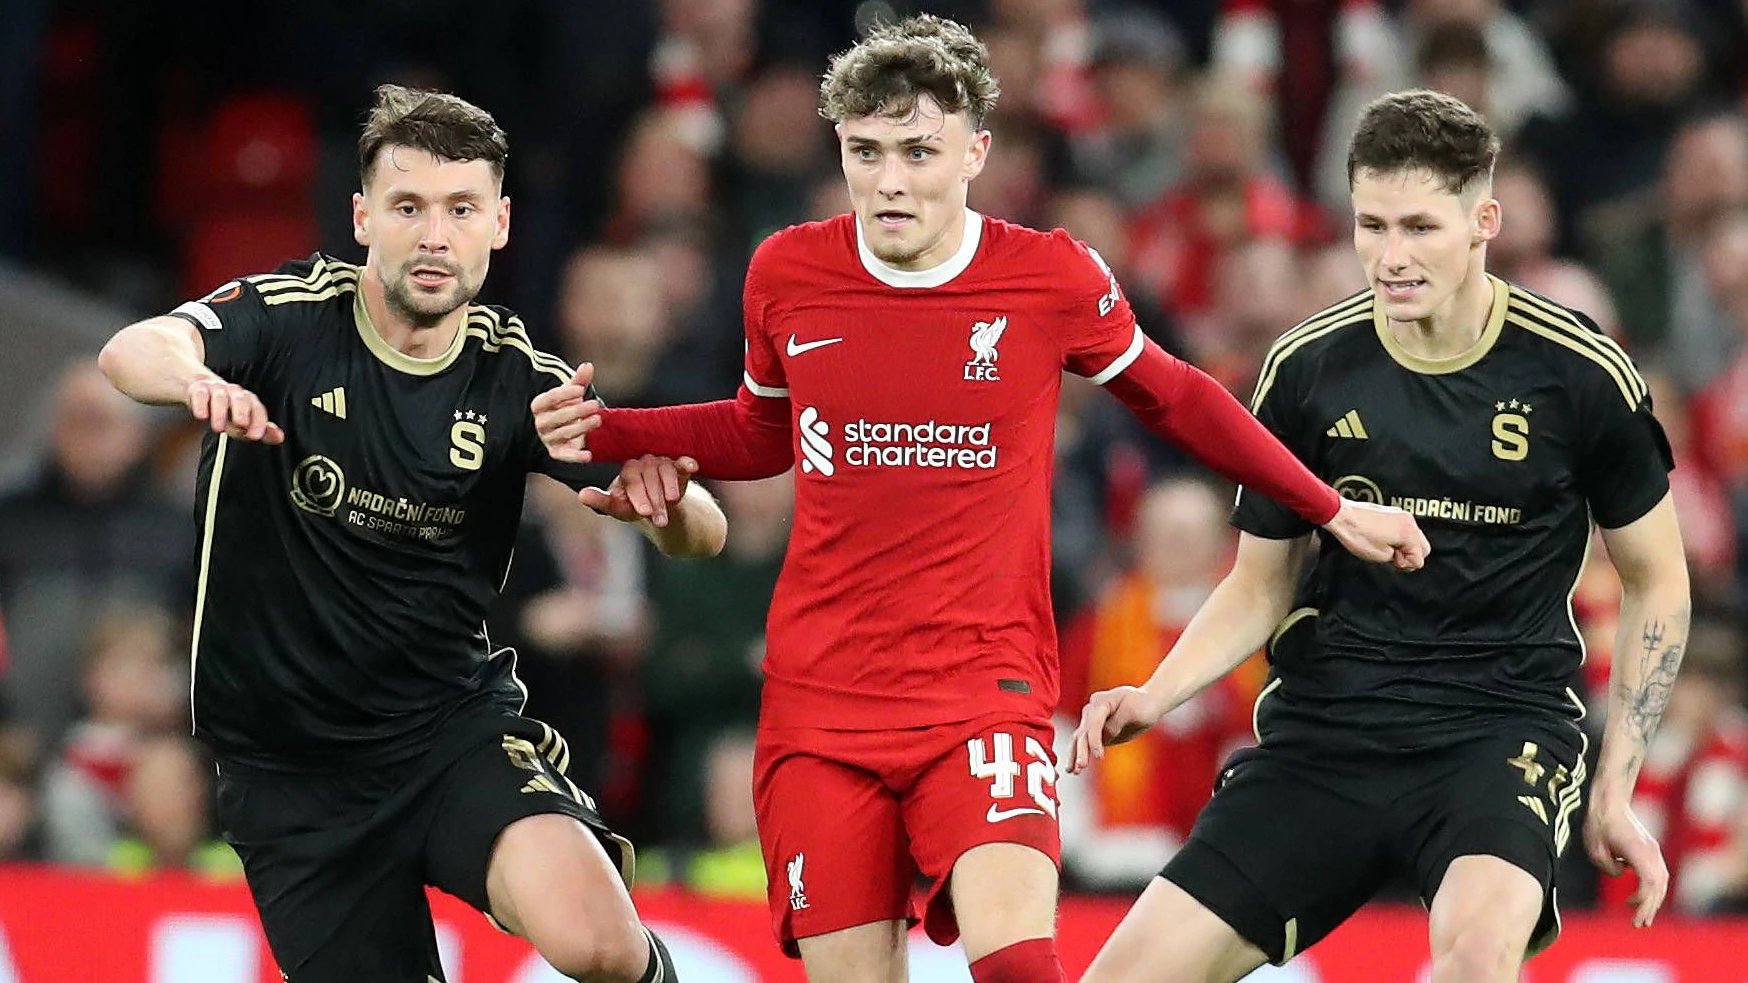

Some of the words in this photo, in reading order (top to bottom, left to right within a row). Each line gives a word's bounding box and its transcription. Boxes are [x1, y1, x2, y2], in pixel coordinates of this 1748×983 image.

[450, 420, 486, 470] S
[844, 418, 991, 446] standard
[1491, 413, 1529, 461] S
[845, 443, 997, 468] chartered
[347, 486, 427, 521] NADAČNÍ
[424, 507, 465, 525] FOND
[348, 510, 366, 526] AC
[1391, 496, 1472, 520] NADAČNÍ
[1473, 505, 1521, 524] FOND
[967, 732, 1058, 821] 42
